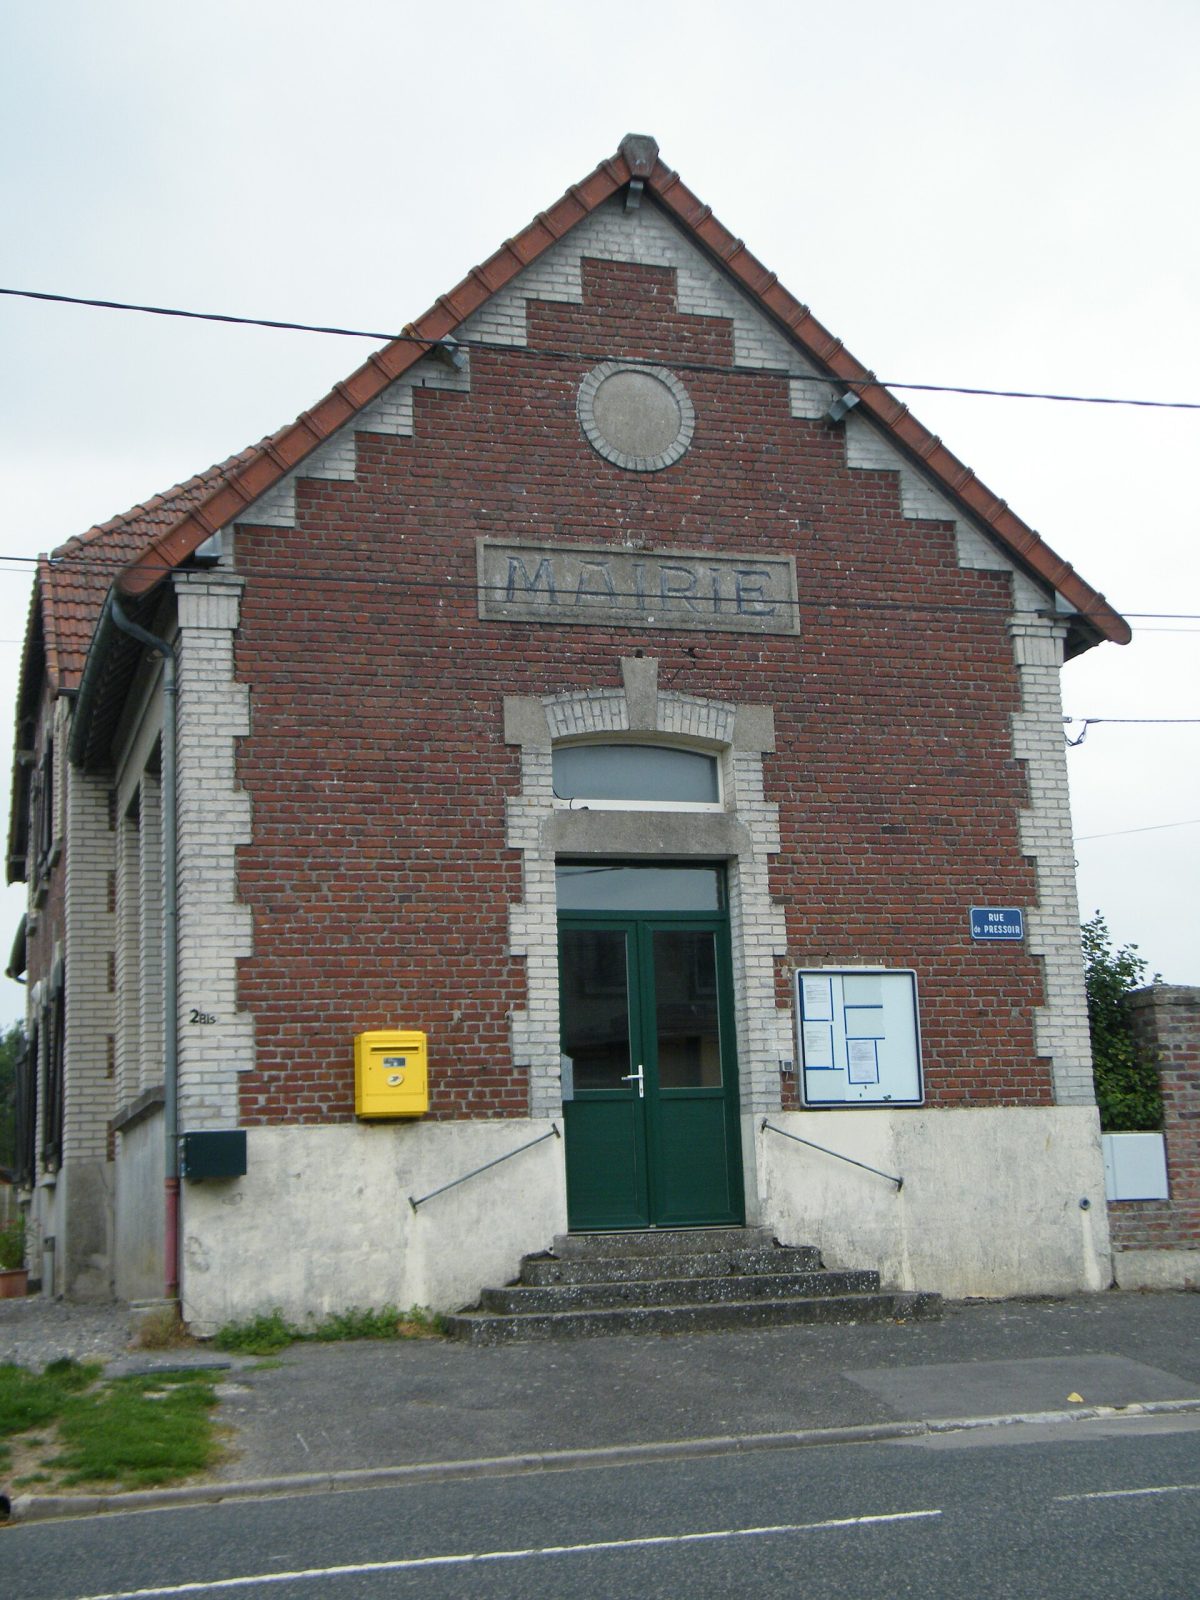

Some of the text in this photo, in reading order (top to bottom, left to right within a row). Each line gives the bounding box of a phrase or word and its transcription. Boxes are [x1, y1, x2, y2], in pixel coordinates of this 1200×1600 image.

[505, 556, 776, 616] MAIRIE
[988, 913, 1004, 922] RUE
[984, 925, 1020, 934] PRESSOIR
